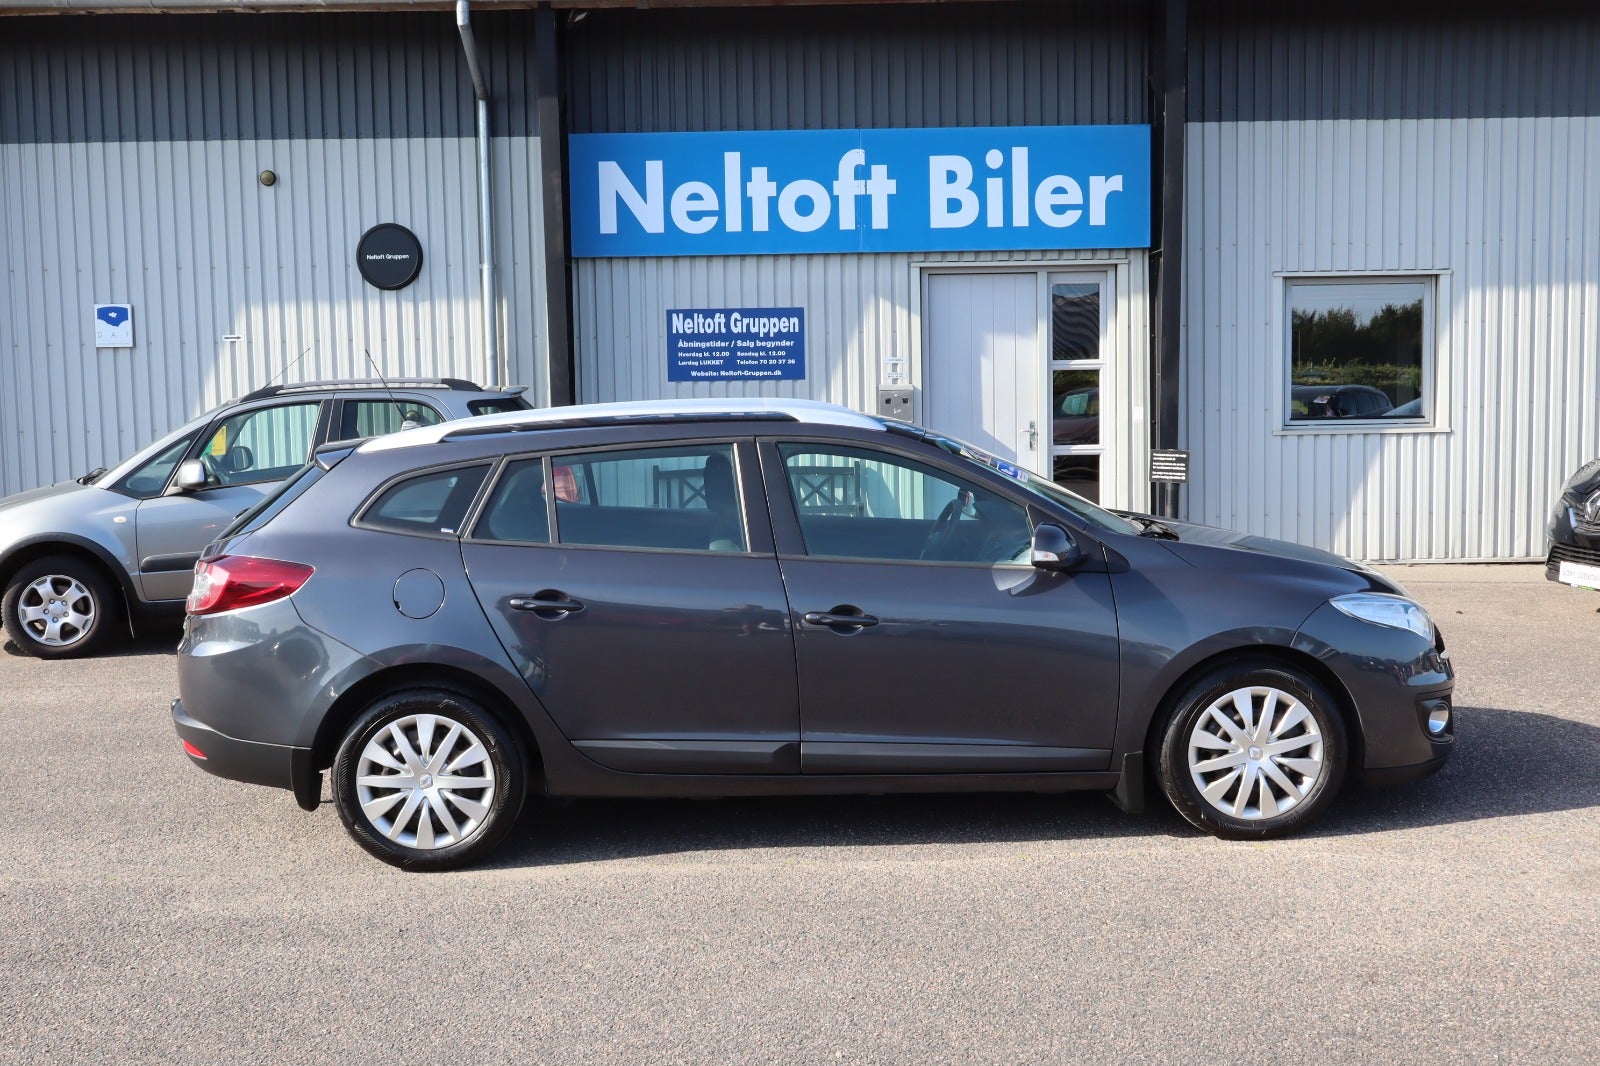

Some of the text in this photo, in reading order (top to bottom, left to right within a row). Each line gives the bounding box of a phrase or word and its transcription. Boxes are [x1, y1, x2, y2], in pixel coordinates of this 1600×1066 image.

[598, 146, 1123, 235] Neltoft Biler
[671, 311, 799, 338] Neltoft Gruppen
[677, 338, 795, 349] Åbningstider / Salg begynder
